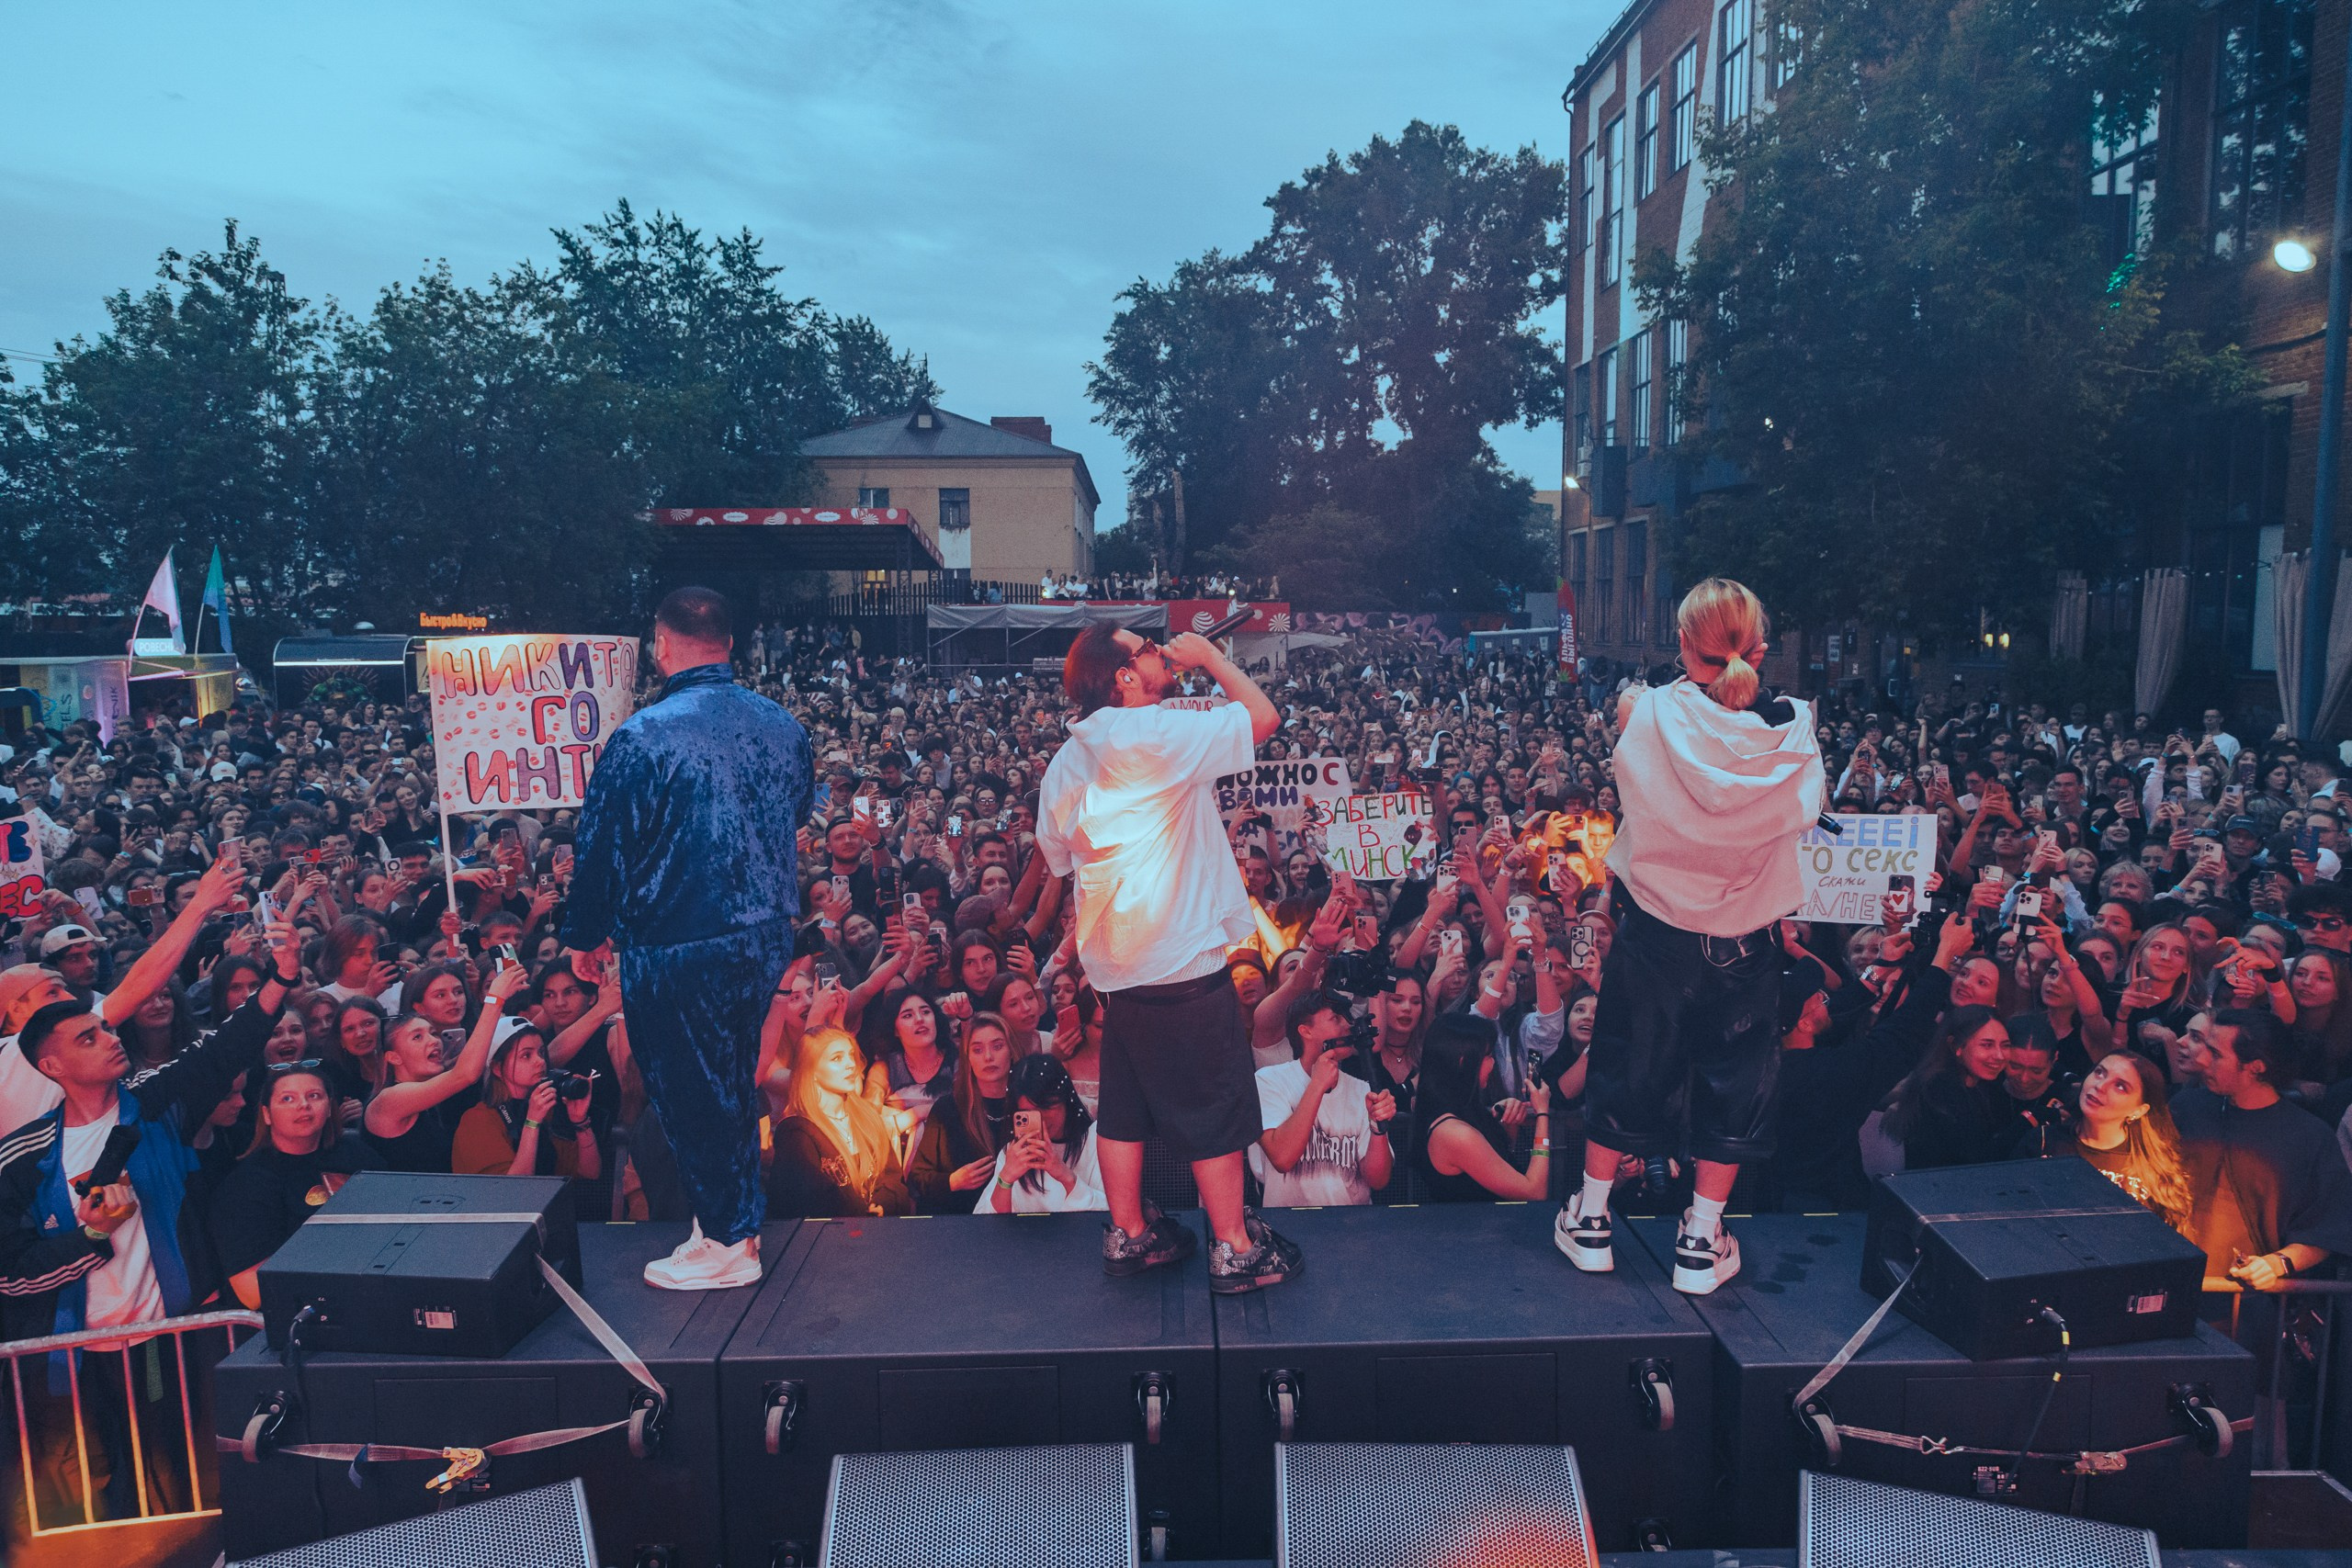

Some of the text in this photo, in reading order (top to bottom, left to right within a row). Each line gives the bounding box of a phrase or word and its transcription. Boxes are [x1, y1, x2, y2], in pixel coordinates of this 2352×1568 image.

[442, 642, 635, 699] НИКИТА
[531, 691, 600, 745] ГО
[1322, 762, 1340, 785] С
[1218, 786, 1298, 812] ВМИ
[1314, 793, 1433, 827] ЗАБЕРИТЕ
[1358, 824, 1380, 848] В
[1796, 888, 1887, 920] А/НЕ
[499, 1104, 513, 1124] Canon
